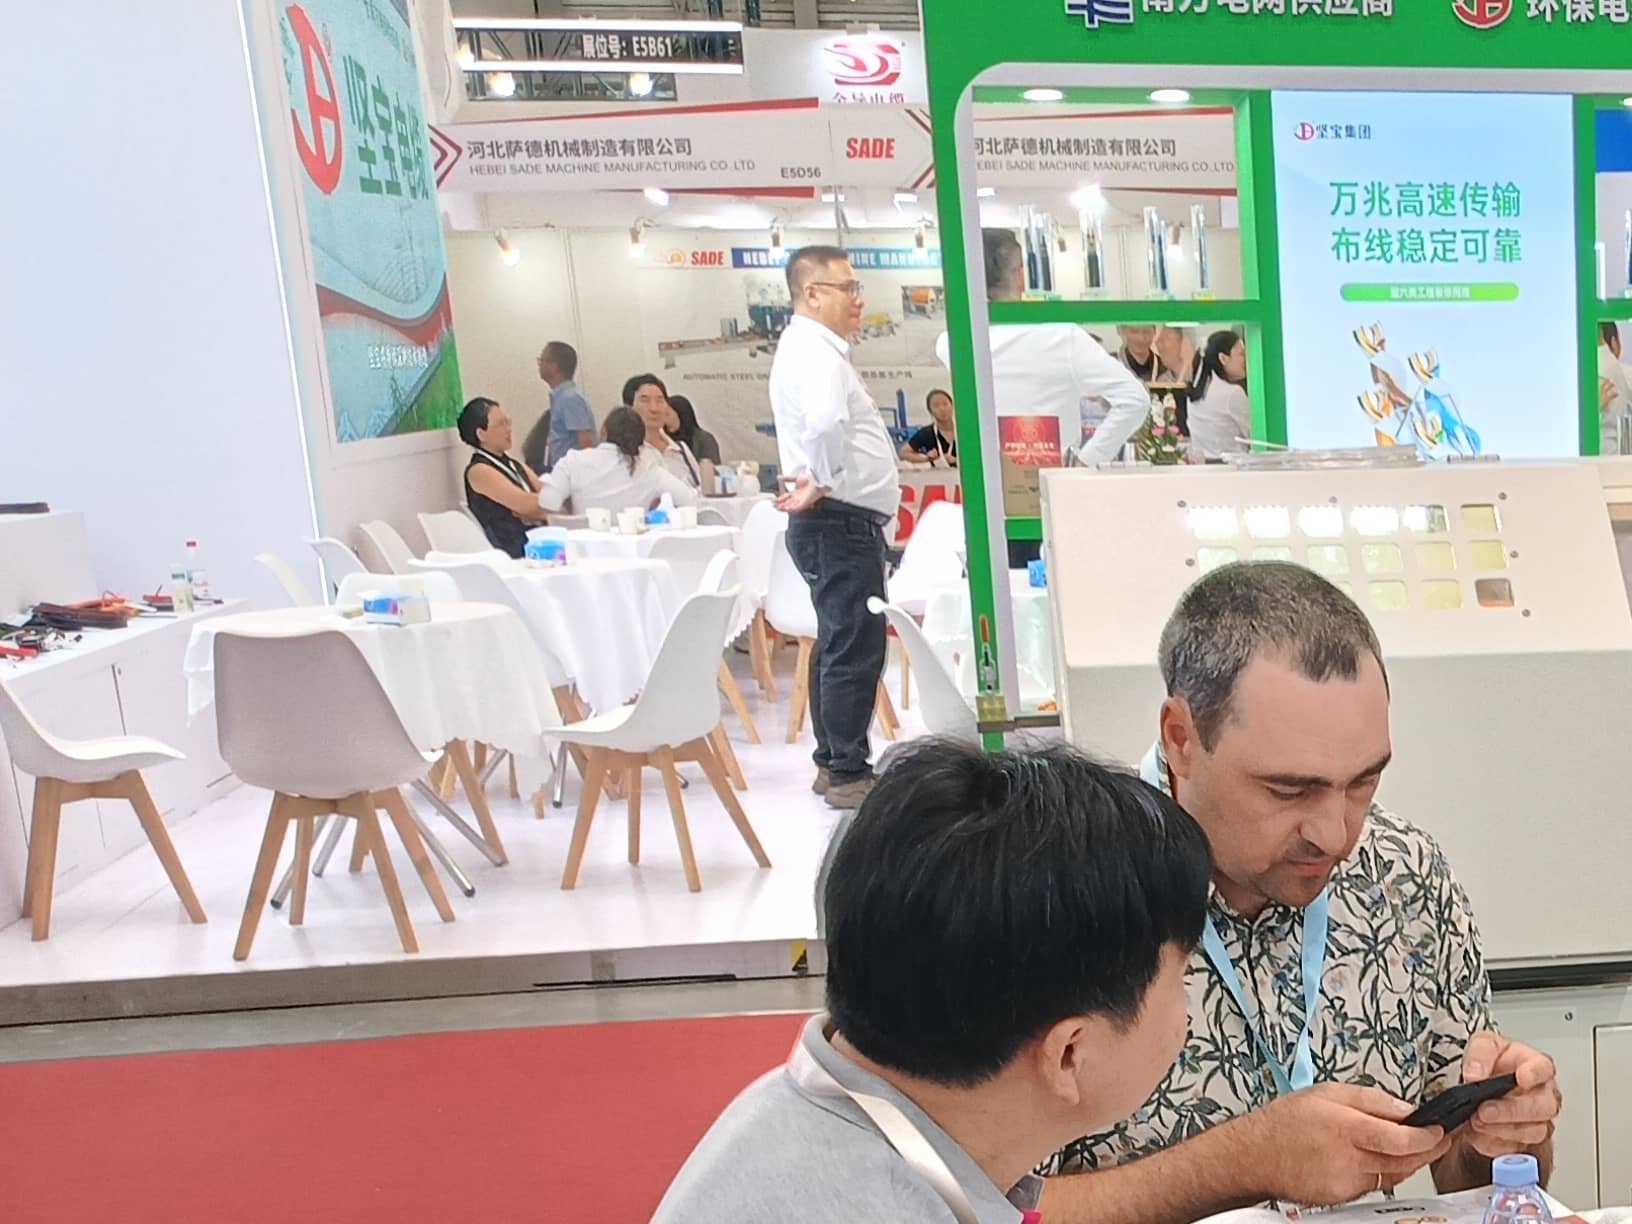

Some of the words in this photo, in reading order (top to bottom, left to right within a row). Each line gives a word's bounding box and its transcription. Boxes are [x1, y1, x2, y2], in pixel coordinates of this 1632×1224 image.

[632, 36, 673, 56] E5B61
[1316, 123, 1371, 140] 坚宝集团
[467, 138, 692, 160] 河北萨德机械制造有限公司
[846, 138, 895, 159] SADE
[469, 164, 507, 176] HEBEI
[510, 162, 543, 175] SADE
[546, 161, 601, 174] MACHINE
[604, 159, 706, 173] MANUFACTURING
[780, 167, 821, 179] E5D56
[977, 160, 1003, 171] EBEI
[1006, 160, 1037, 171] SADE
[1040, 160, 1090, 171] MACHINE
[1093, 161, 1190, 172] MANUFACTURING
[1329, 181, 1521, 218] 万兆高速传输
[1331, 227, 1522, 264] 布线稳定可靠
[691, 251, 725, 266] SADE
